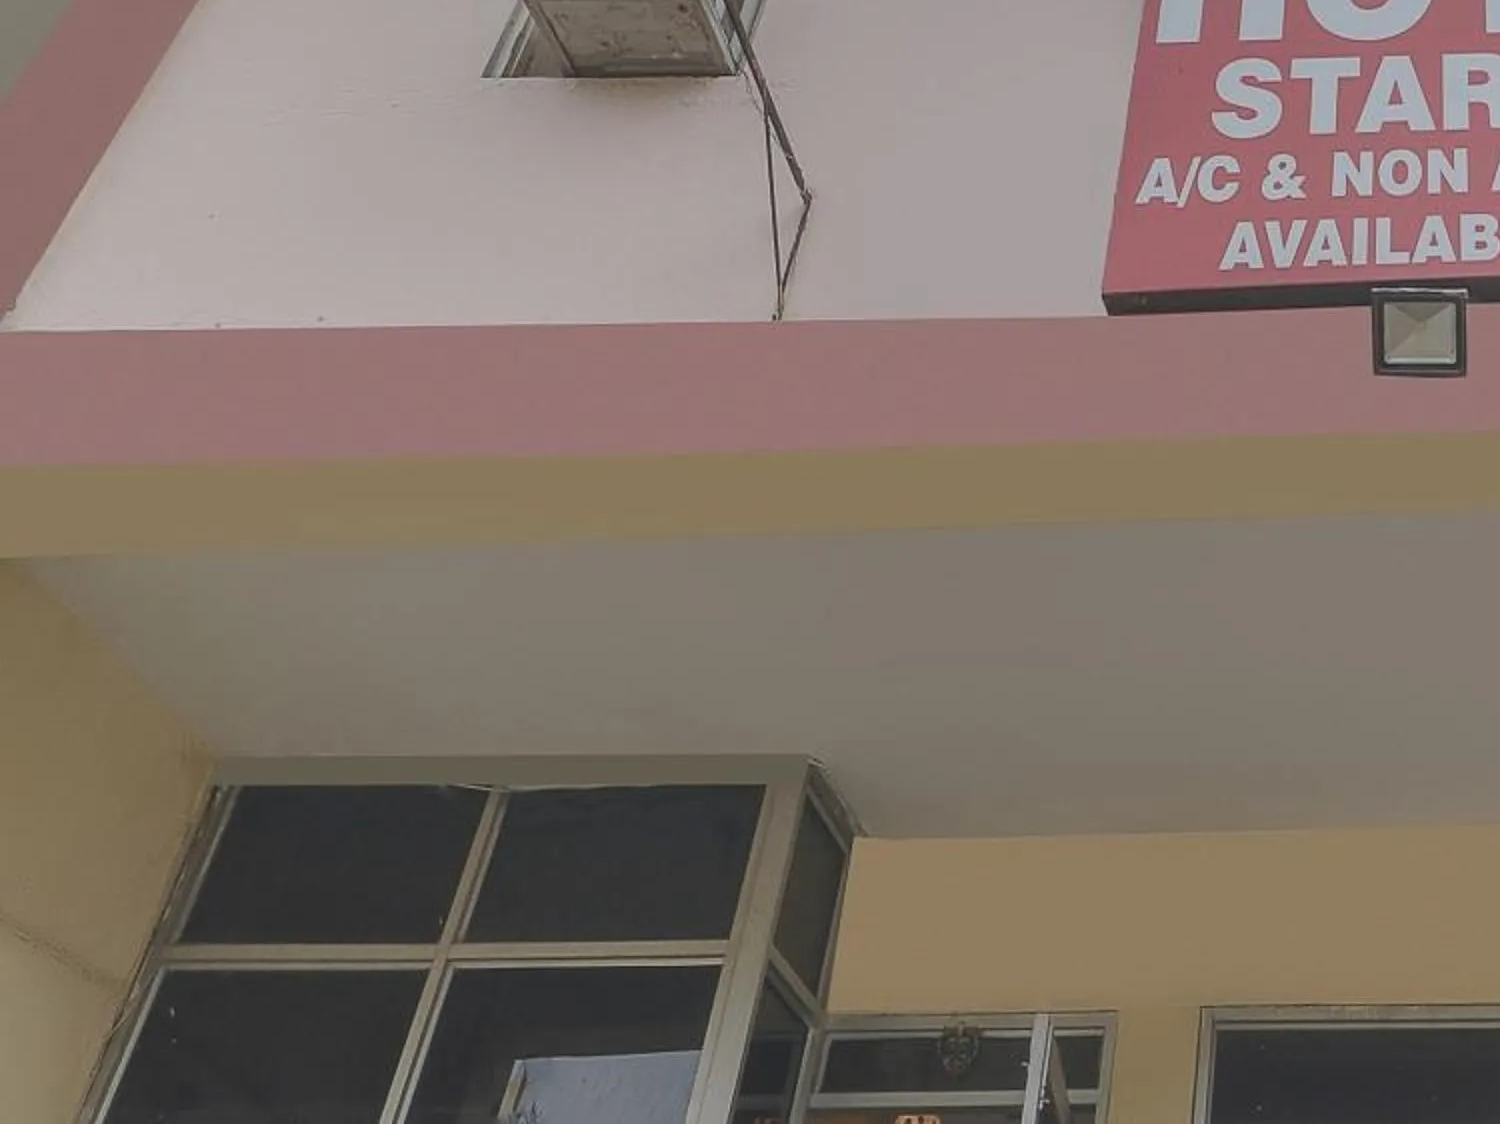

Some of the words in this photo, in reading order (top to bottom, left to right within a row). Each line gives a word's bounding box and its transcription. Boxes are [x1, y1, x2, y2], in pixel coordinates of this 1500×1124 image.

[1135, 155, 1240, 208] A/C
[1261, 155, 1308, 201] &
[1330, 147, 1469, 197] NON
